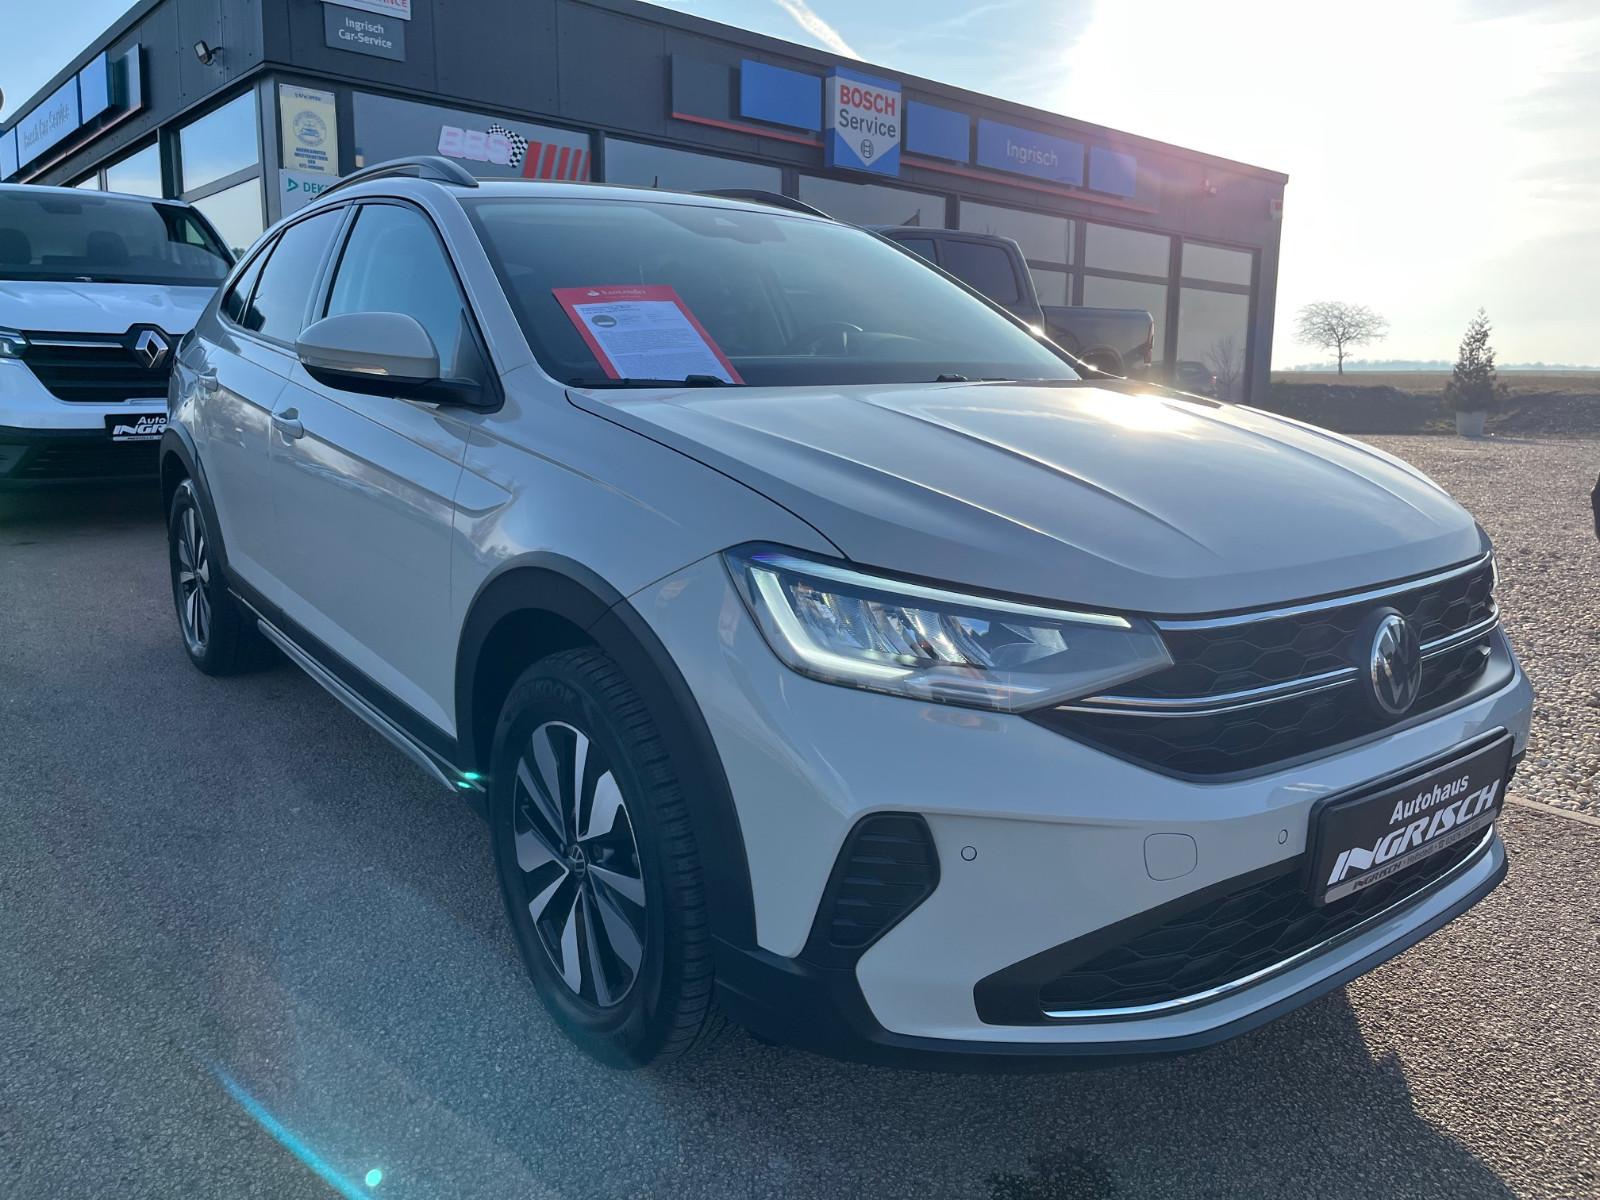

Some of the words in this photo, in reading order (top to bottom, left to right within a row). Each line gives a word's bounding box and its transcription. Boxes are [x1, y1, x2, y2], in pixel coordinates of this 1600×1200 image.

[338, 29, 392, 49] Car-Service
[345, 17, 384, 34] Ingrisch
[840, 84, 896, 117] BOSCH
[839, 108, 896, 138] Service
[1006, 139, 1058, 167] Ingrisch
[303, 182, 330, 193] DEK
[1389, 775, 1469, 825] Autohaus
[1327, 779, 1500, 886] INGRISCH
